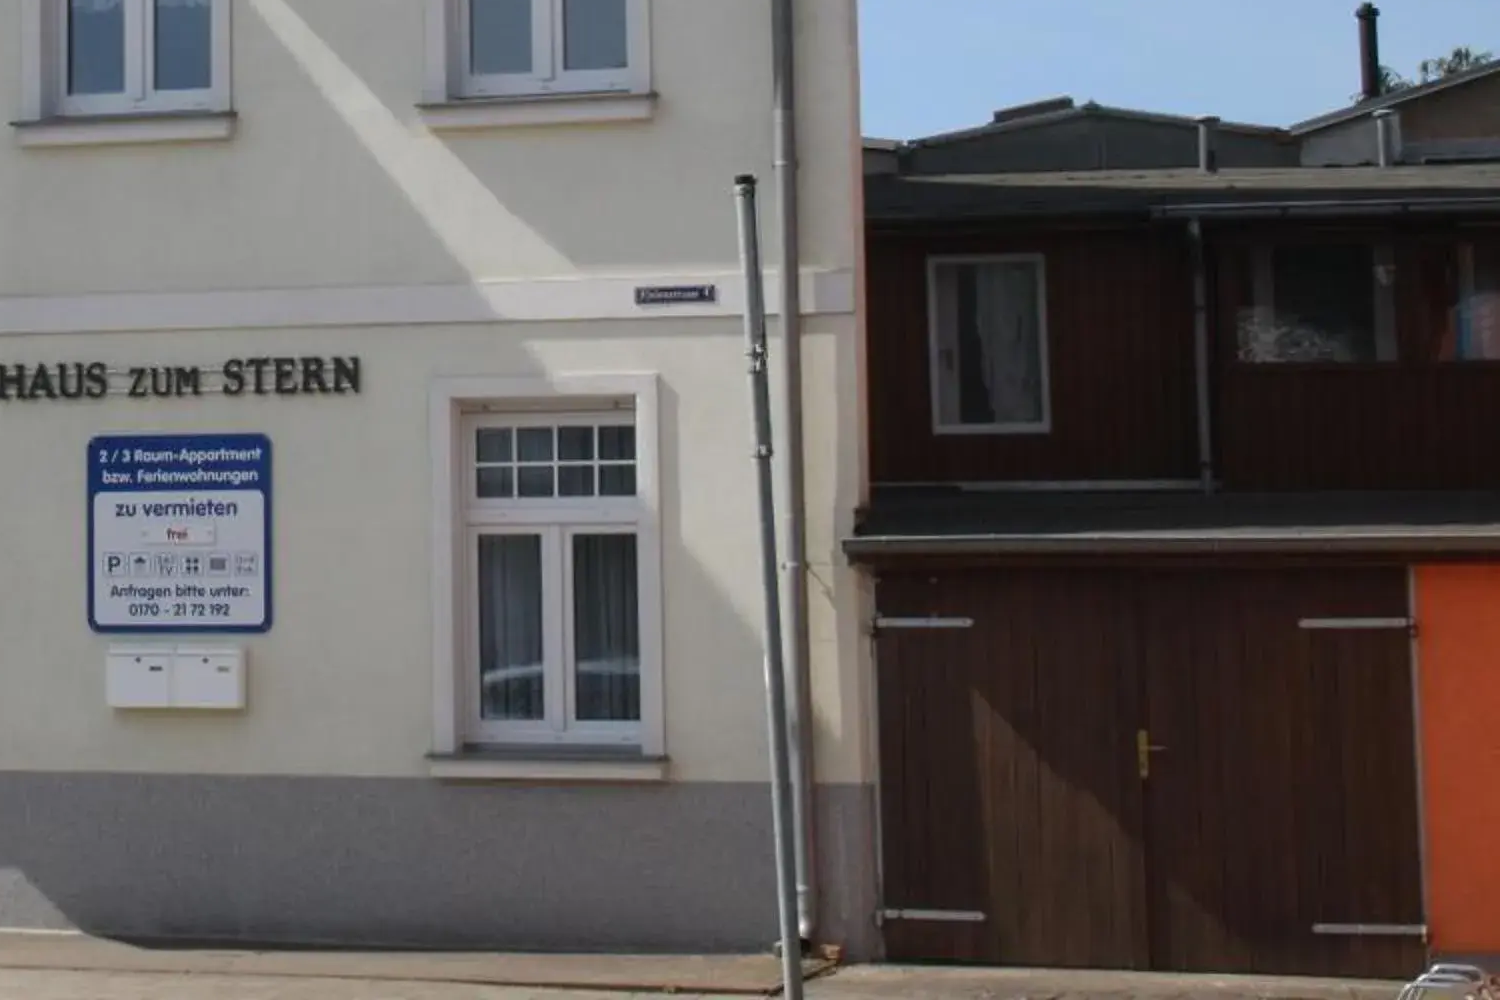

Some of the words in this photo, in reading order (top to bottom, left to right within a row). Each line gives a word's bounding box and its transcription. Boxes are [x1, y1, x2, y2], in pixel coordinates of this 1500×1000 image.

[129, 366, 200, 398] ZUM
[223, 356, 361, 395] STERN
[100, 449, 108, 463] 2
[121, 449, 131, 463] 3
[137, 467, 259, 485] Ferienwohnungen
[115, 503, 137, 517] zu
[142, 497, 238, 517] vermieten
[166, 527, 188, 540] frei
[108, 556, 120, 572] P
[110, 584, 171, 600] Anfragen
[175, 584, 205, 597] bitte
[129, 603, 159, 617] 0170
